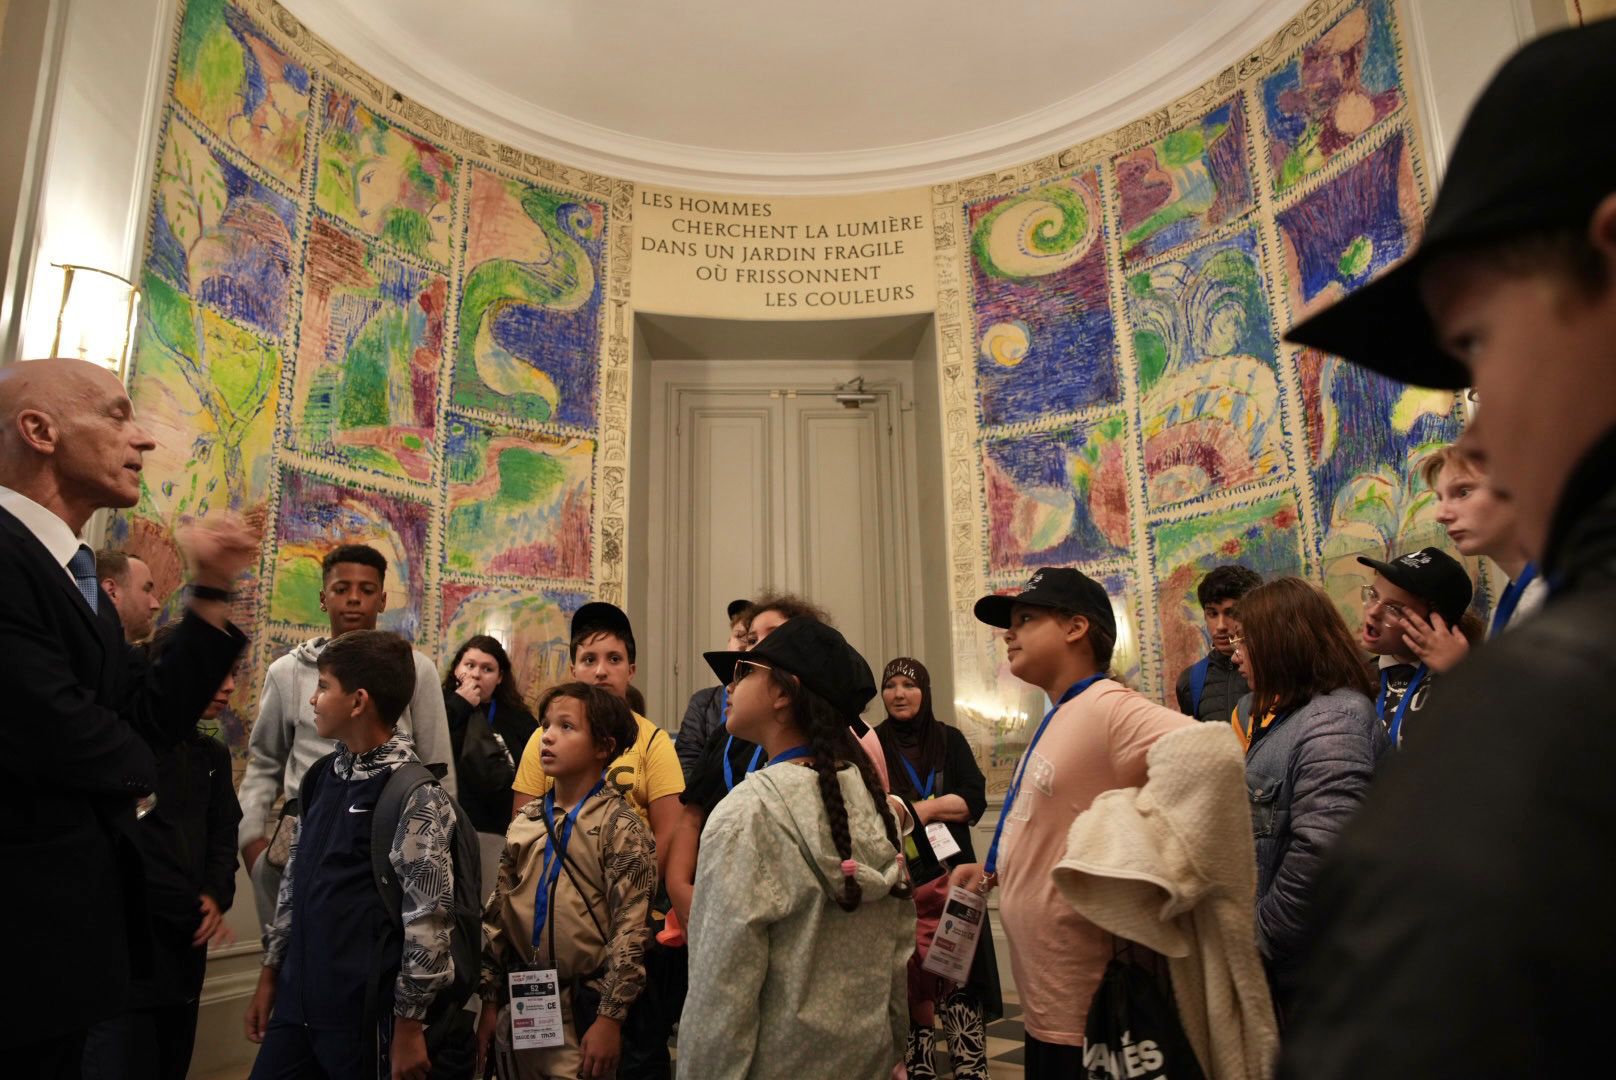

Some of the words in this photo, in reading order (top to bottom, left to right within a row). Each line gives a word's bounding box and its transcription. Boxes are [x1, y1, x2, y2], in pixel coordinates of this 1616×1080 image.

[641, 191, 673, 209] LES
[680, 197, 772, 218] HOMMES
[672, 218, 798, 239] CHERCHENT
[805, 224, 829, 239] LA
[837, 215, 924, 238] LUMIÈRE
[641, 236, 697, 257] DANS
[705, 244, 735, 260] UN
[741, 247, 816, 264] JARDIN
[824, 240, 904, 261] FRAGILE
[696, 264, 728, 282] OÙ
[736, 265, 881, 284] FRISSONNENT
[766, 292, 798, 308] LES
[805, 285, 914, 307] COULEURS
[547, 1002, 556, 1010] CE
